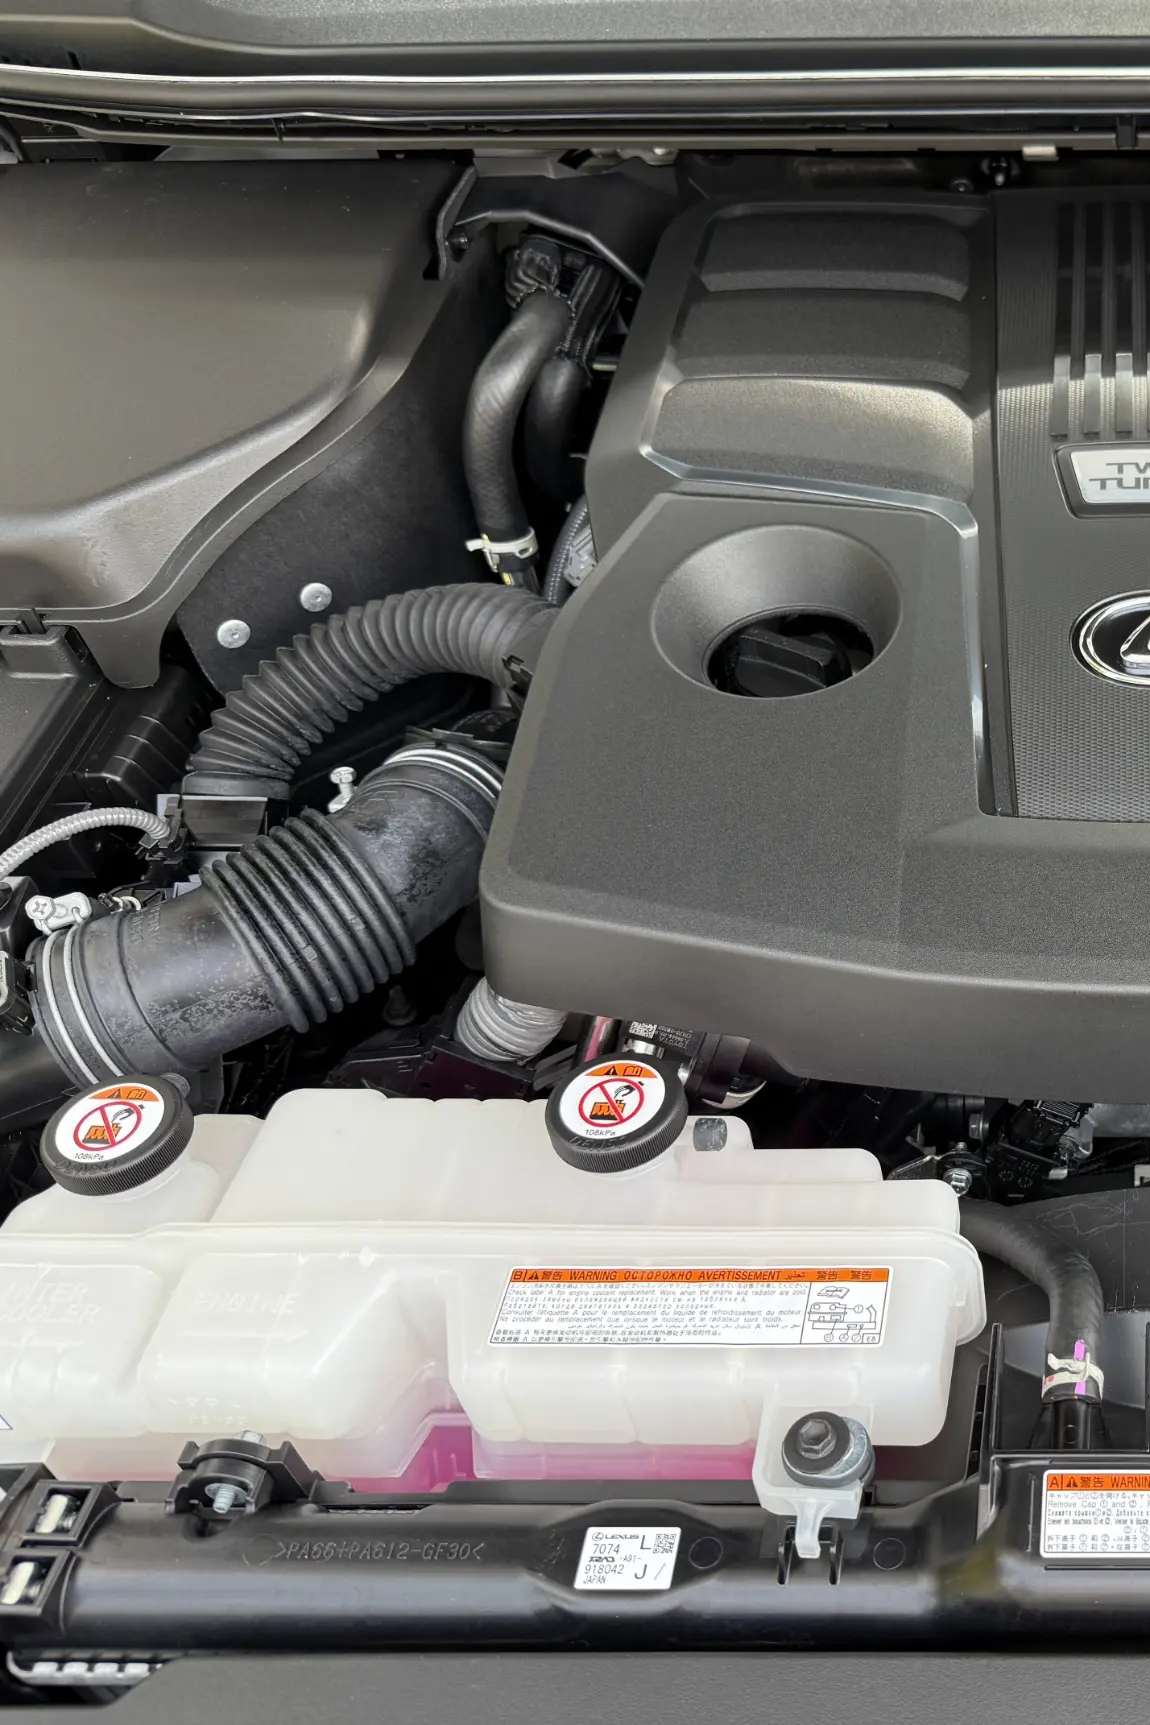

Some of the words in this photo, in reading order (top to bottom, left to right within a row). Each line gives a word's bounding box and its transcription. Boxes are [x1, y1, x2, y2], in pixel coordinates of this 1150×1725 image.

[659, 1036, 688, 1049] TOYOTA
[584, 1129, 616, 1137] 108kPa
[74, 1152, 105, 1160] 108kPa
[513, 1271, 523, 1281] B
[542, 1271, 563, 1281] 警告
[569, 1271, 617, 1281] WARNING
[623, 1271, 692, 1281] ОСТОРОЖНО
[698, 1271, 782, 1281] AVERTISSEMENT
[1049, 1476, 1060, 1488] A
[1080, 1476, 1104, 1488] 警告
[1047, 1500, 1077, 1508] Remove
[1081, 1500, 1097, 1508] Cap
[1111, 1500, 1126, 1508] and
[640, 1535, 651, 1550] L
[593, 1543, 620, 1555] 7074
[584, 1564, 625, 1575] 918042
[634, 1564, 648, 1580] J
[582, 1575, 607, 1584] JAPAN
